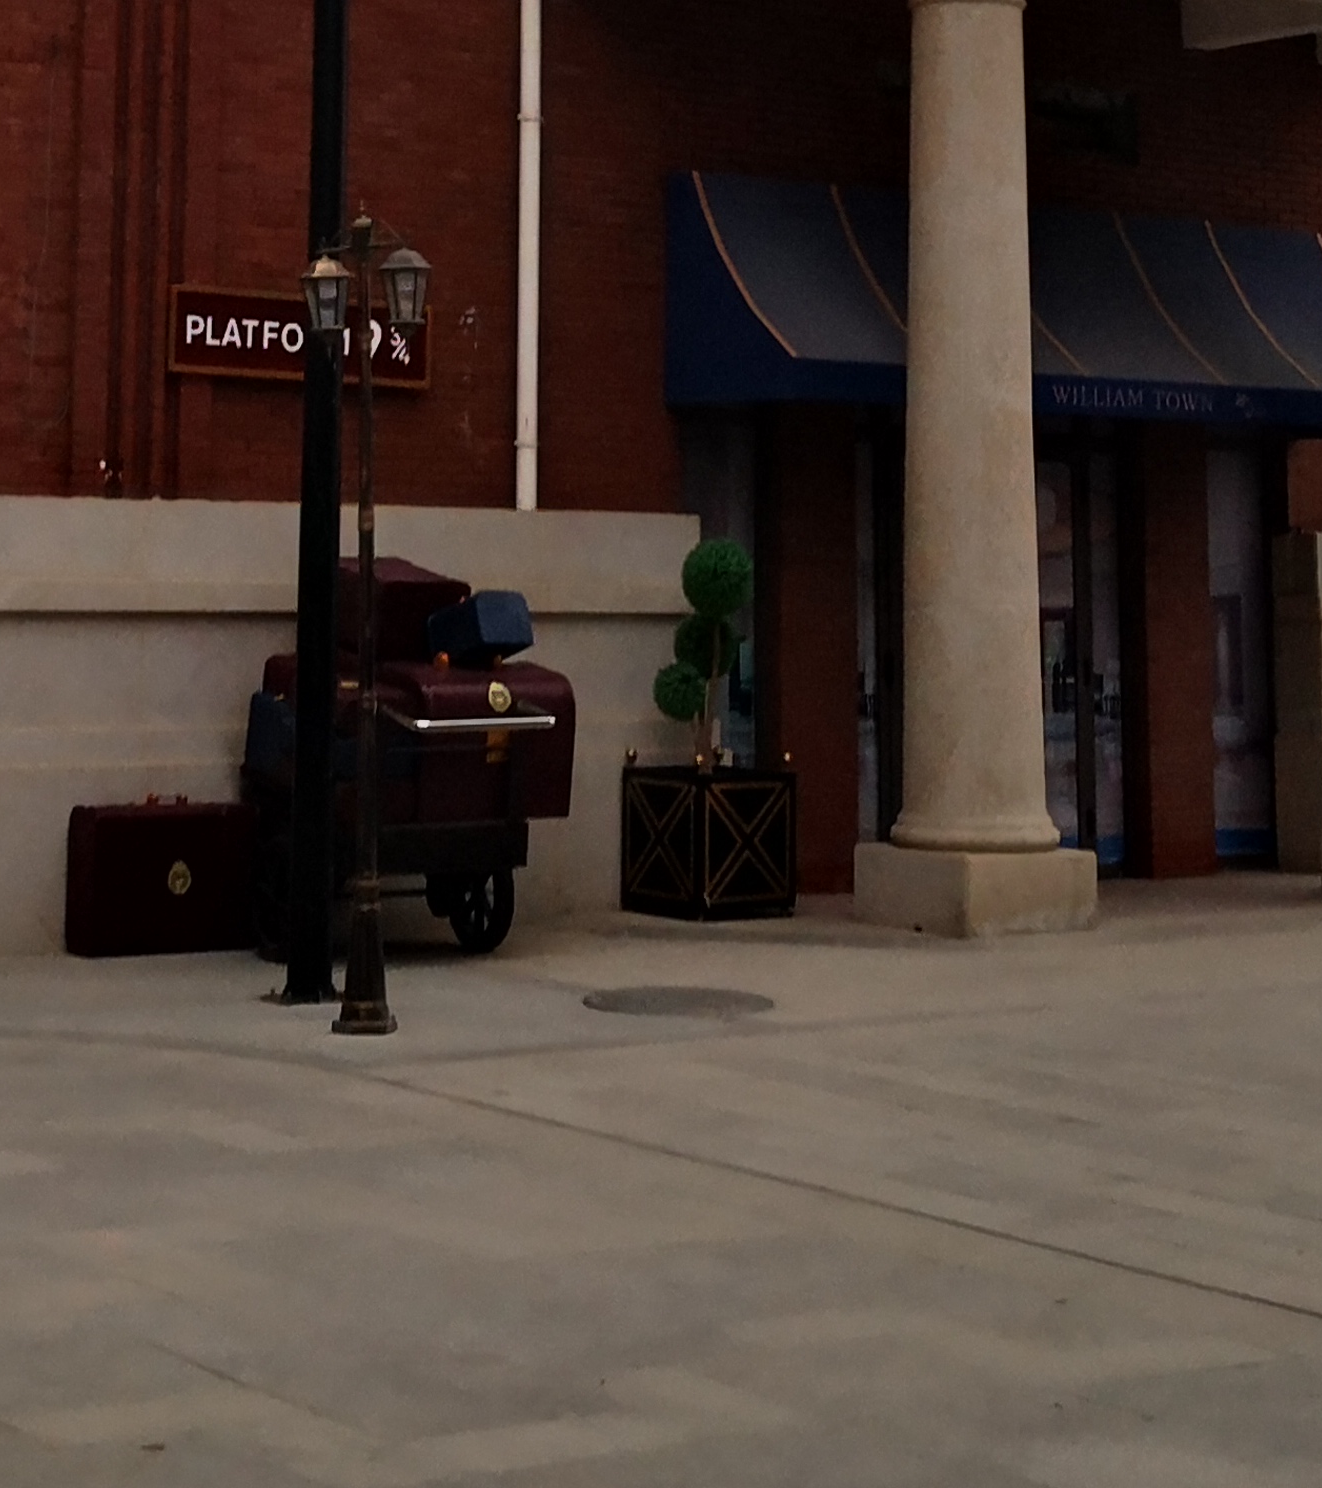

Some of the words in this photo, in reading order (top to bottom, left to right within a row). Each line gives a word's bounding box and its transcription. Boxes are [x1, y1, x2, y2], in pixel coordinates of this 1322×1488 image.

[185, 314, 351, 358] PLATFO
[1051, 384, 1144, 409] WILLIAM
[1153, 390, 1213, 413] TOWN
